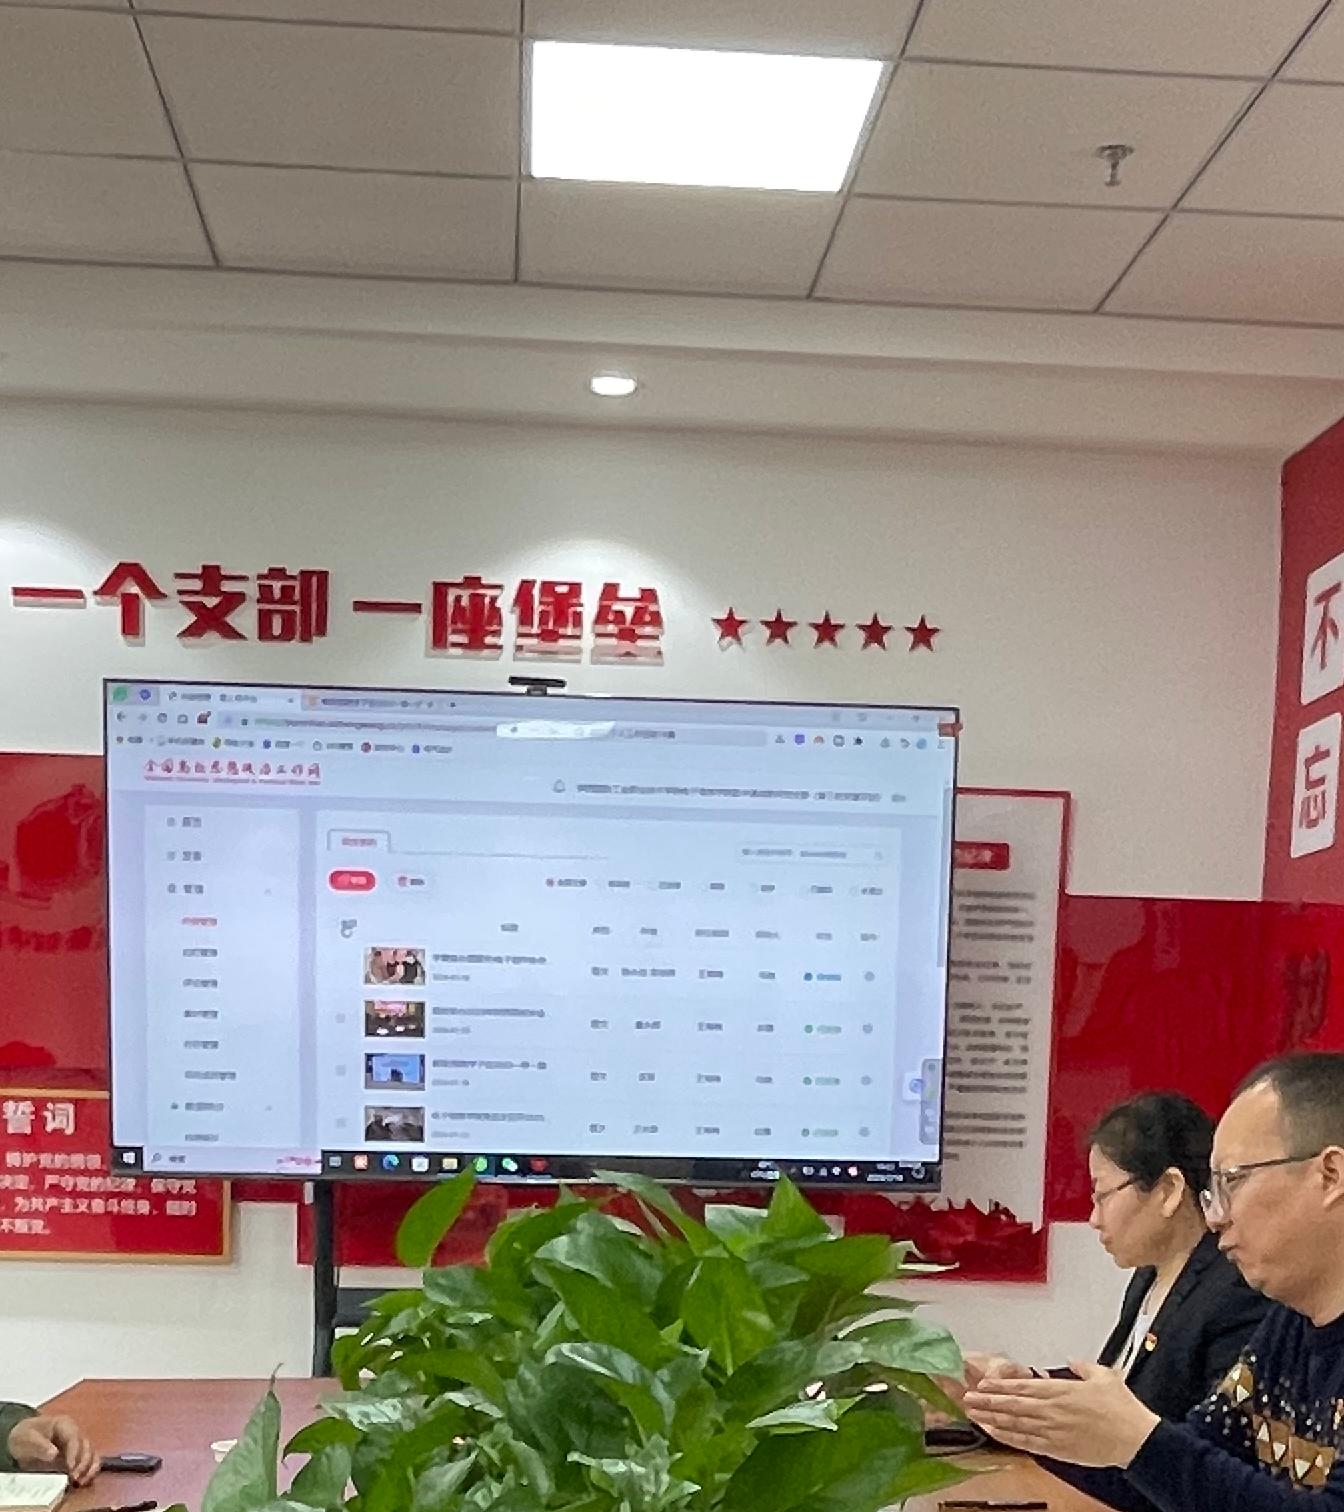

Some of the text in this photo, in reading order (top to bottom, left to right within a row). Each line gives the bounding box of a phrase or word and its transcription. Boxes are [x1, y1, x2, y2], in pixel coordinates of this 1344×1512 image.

[12, 562, 329, 644] 一个支部
[353, 575, 664, 657] 一座堡垒
